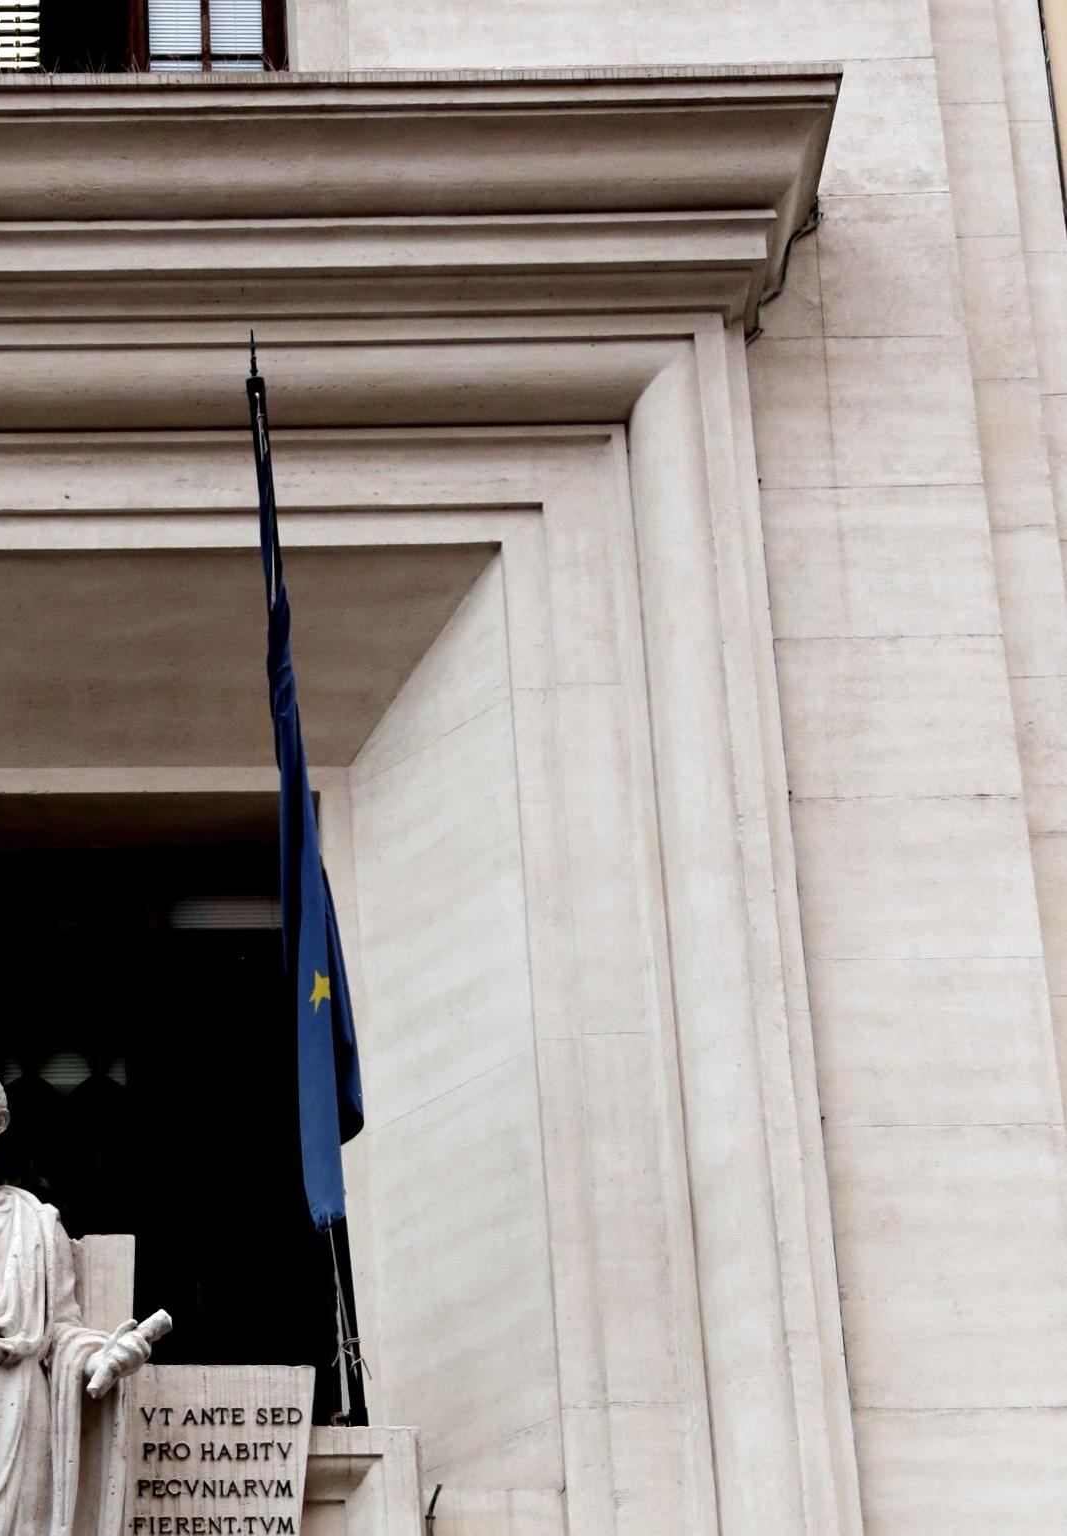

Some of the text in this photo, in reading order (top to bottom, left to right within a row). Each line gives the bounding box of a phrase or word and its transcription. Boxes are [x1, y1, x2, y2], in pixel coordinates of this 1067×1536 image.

[140, 1407, 303, 1426] VT ANTE SED
[143, 1442, 293, 1461] PRO HABITV
[137, 1479, 294, 1498] PECVNIARVM
